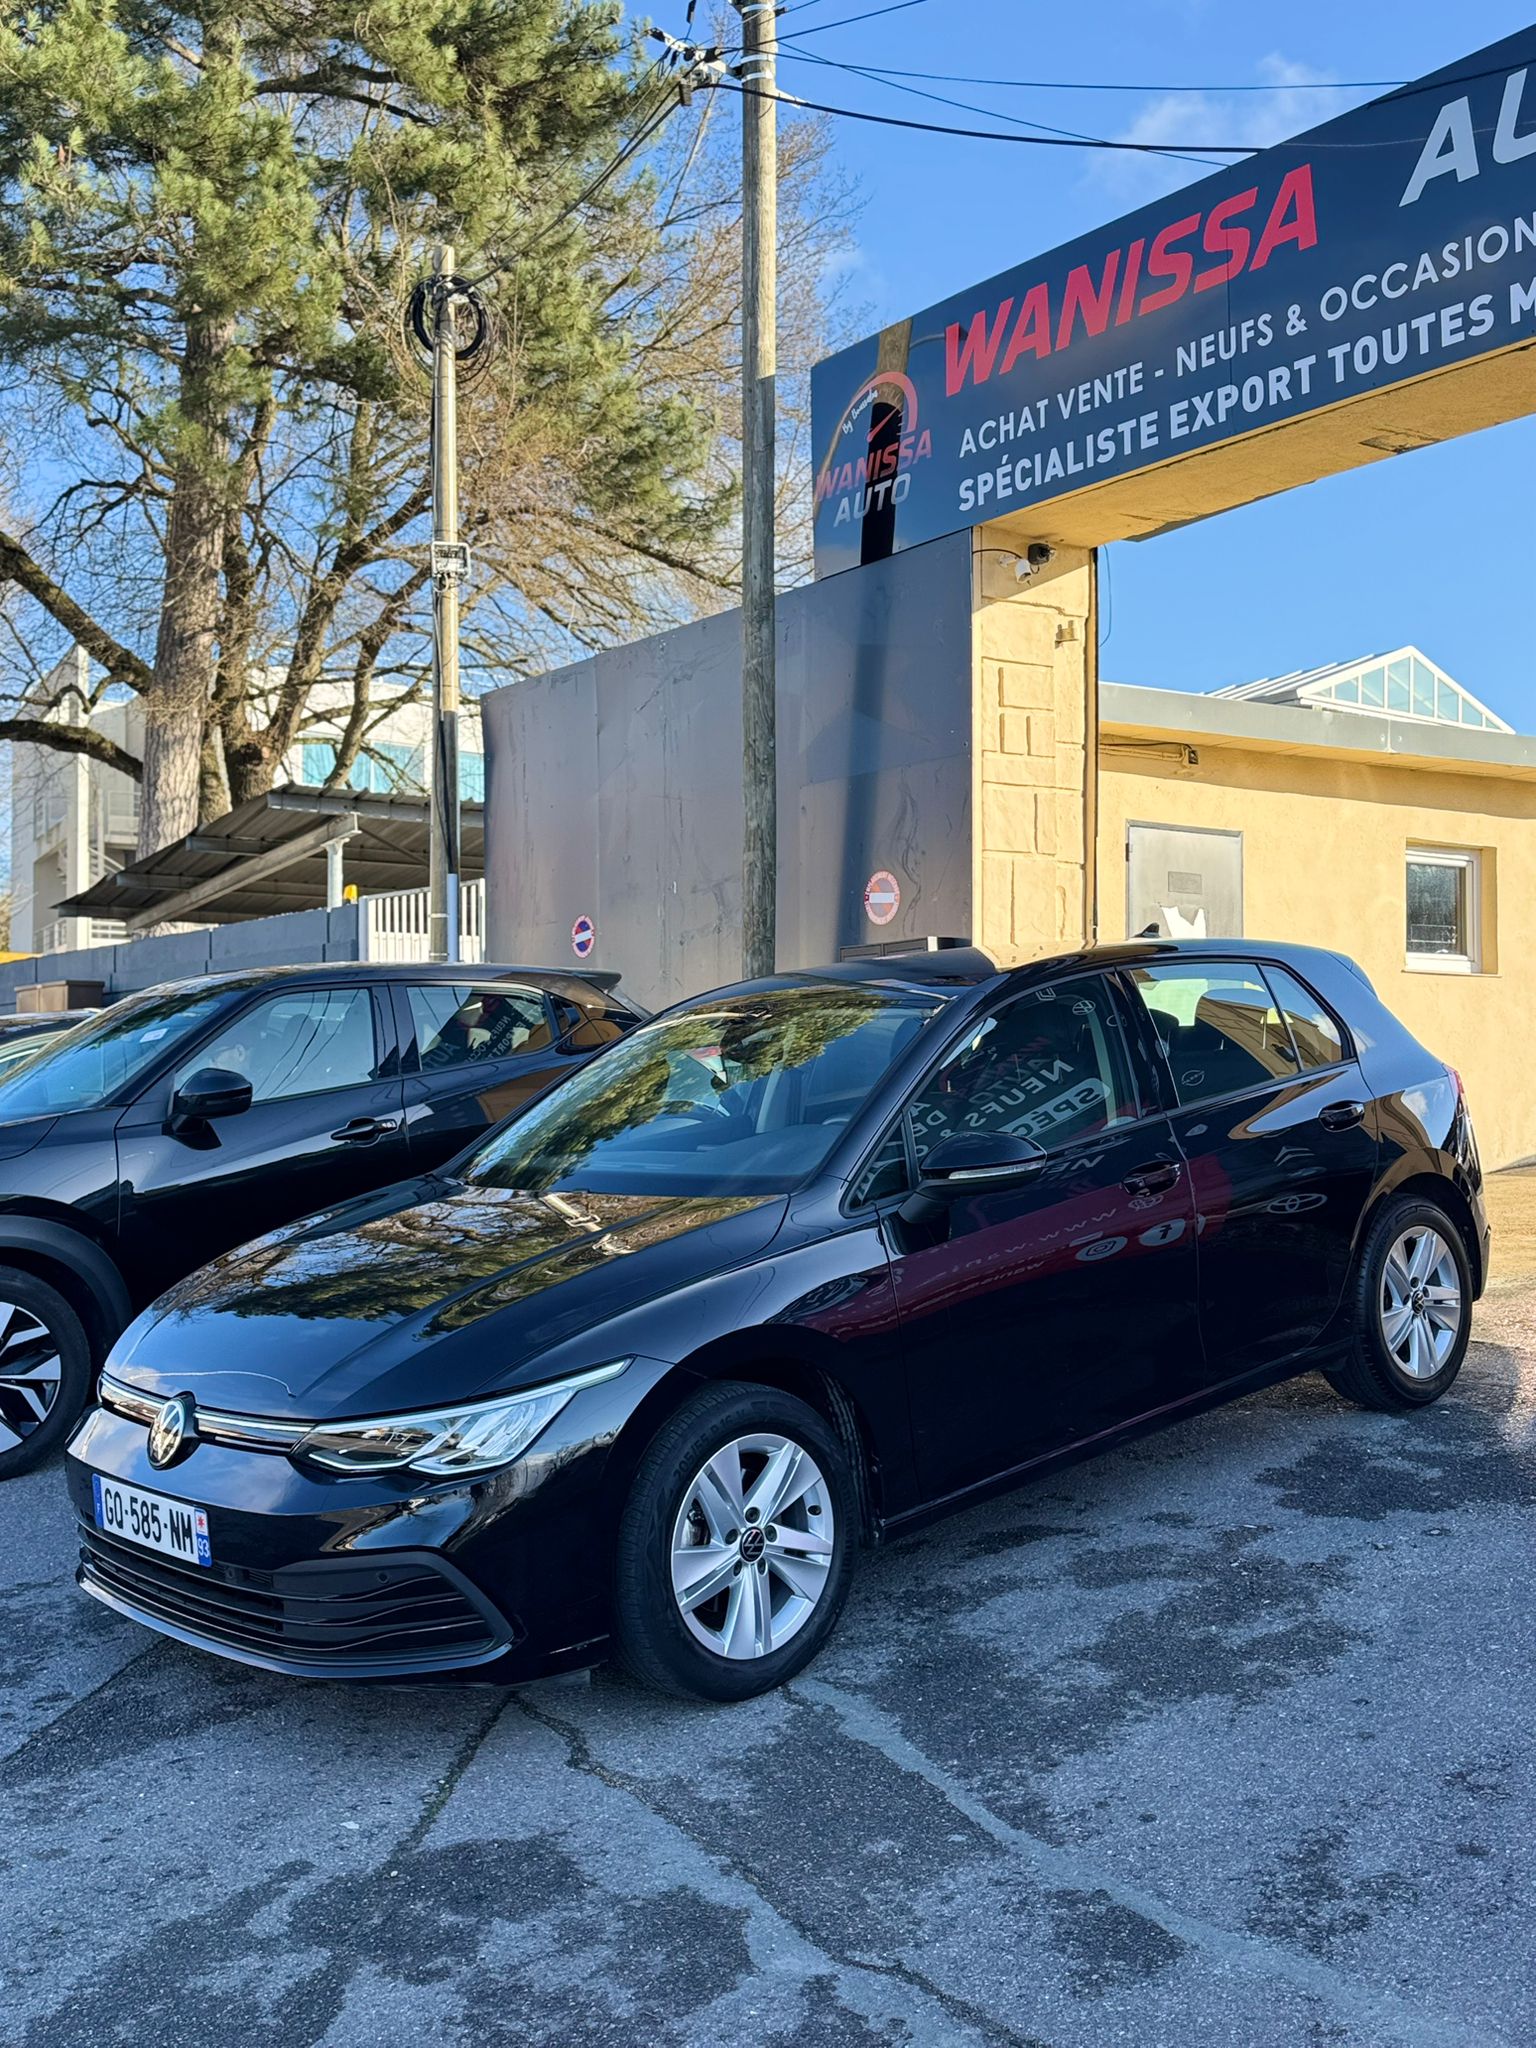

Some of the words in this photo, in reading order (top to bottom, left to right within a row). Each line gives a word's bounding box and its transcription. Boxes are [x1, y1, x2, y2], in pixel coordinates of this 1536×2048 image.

[945, 164, 1318, 398] WANISSA
[959, 398, 1049, 459] ACHAT
[1057, 366, 1144, 420] VENTE
[1176, 313, 1273, 378] NEUFS
[1285, 303, 1308, 337] &
[1320, 211, 1536, 322] OCCASION
[958, 410, 1159, 512] SPÉCIALISTE
[1169, 354, 1317, 440] EXPORT
[1327, 293, 1495, 384] TOUTES
[814, 428, 933, 502] WANISSA
[833, 472, 912, 528] AUTO
[104, 1487, 194, 1555] GQ-585-NM
[198, 1537, 211, 1558] 93
